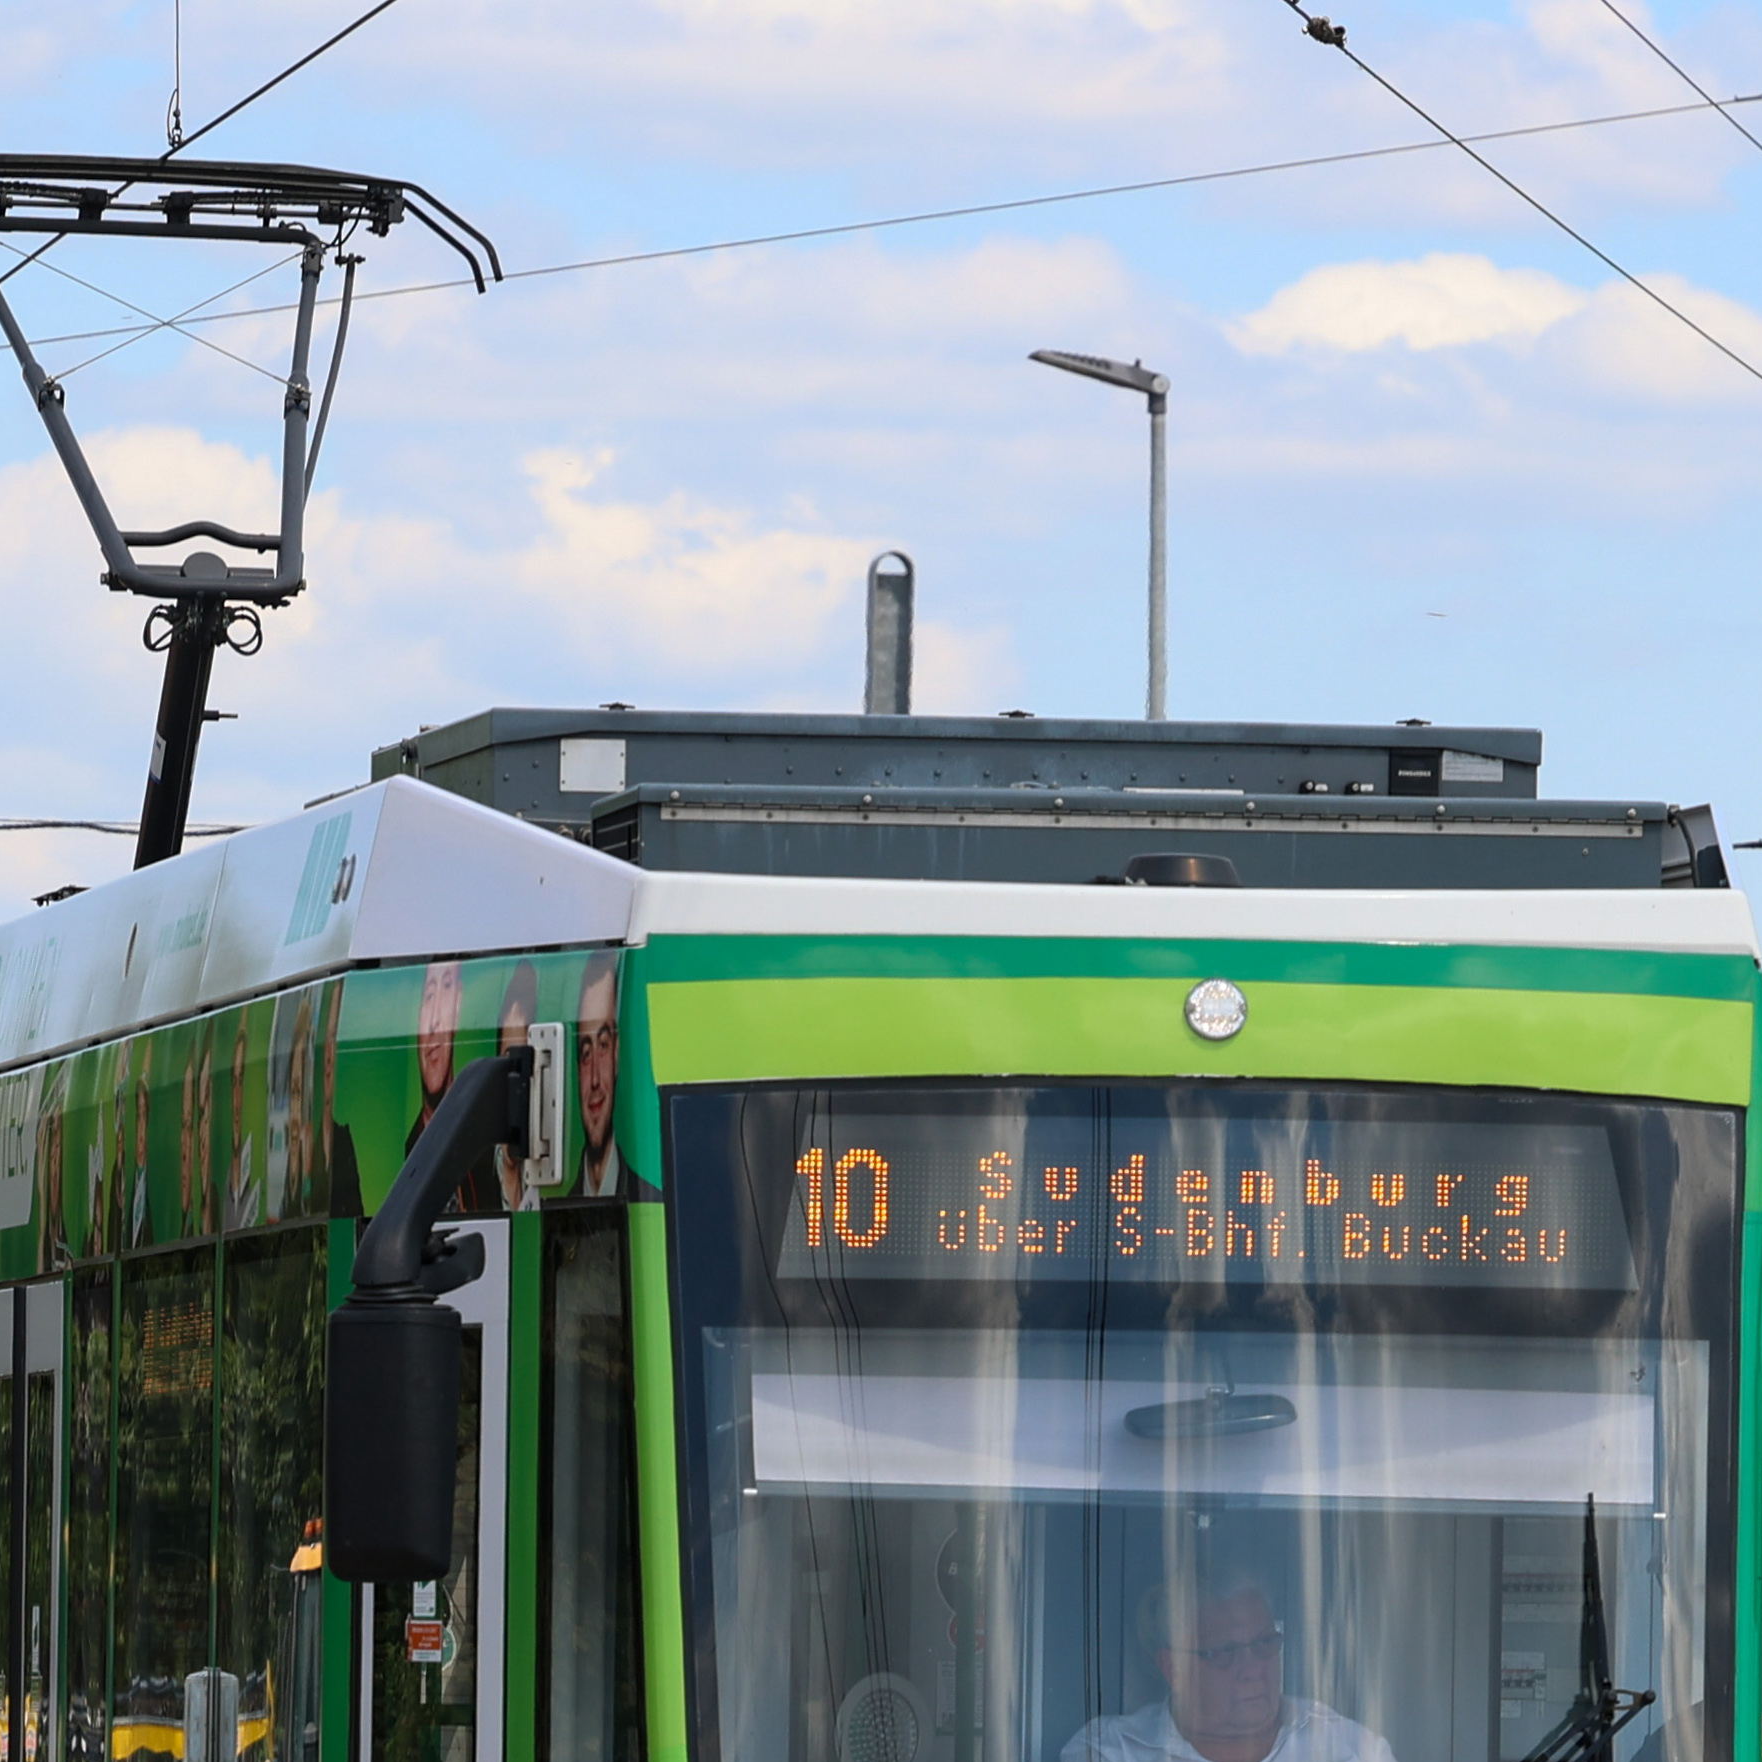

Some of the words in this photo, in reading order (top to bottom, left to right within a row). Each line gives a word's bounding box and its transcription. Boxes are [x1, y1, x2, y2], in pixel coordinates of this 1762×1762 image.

[793, 1147, 890, 1248] 10
[979, 1150, 1531, 1216] Sudenburg
[937, 1203, 1078, 1254] über
[1114, 1206, 1307, 1258] S-Bhf.
[1342, 1211, 1568, 1263] Buckau
